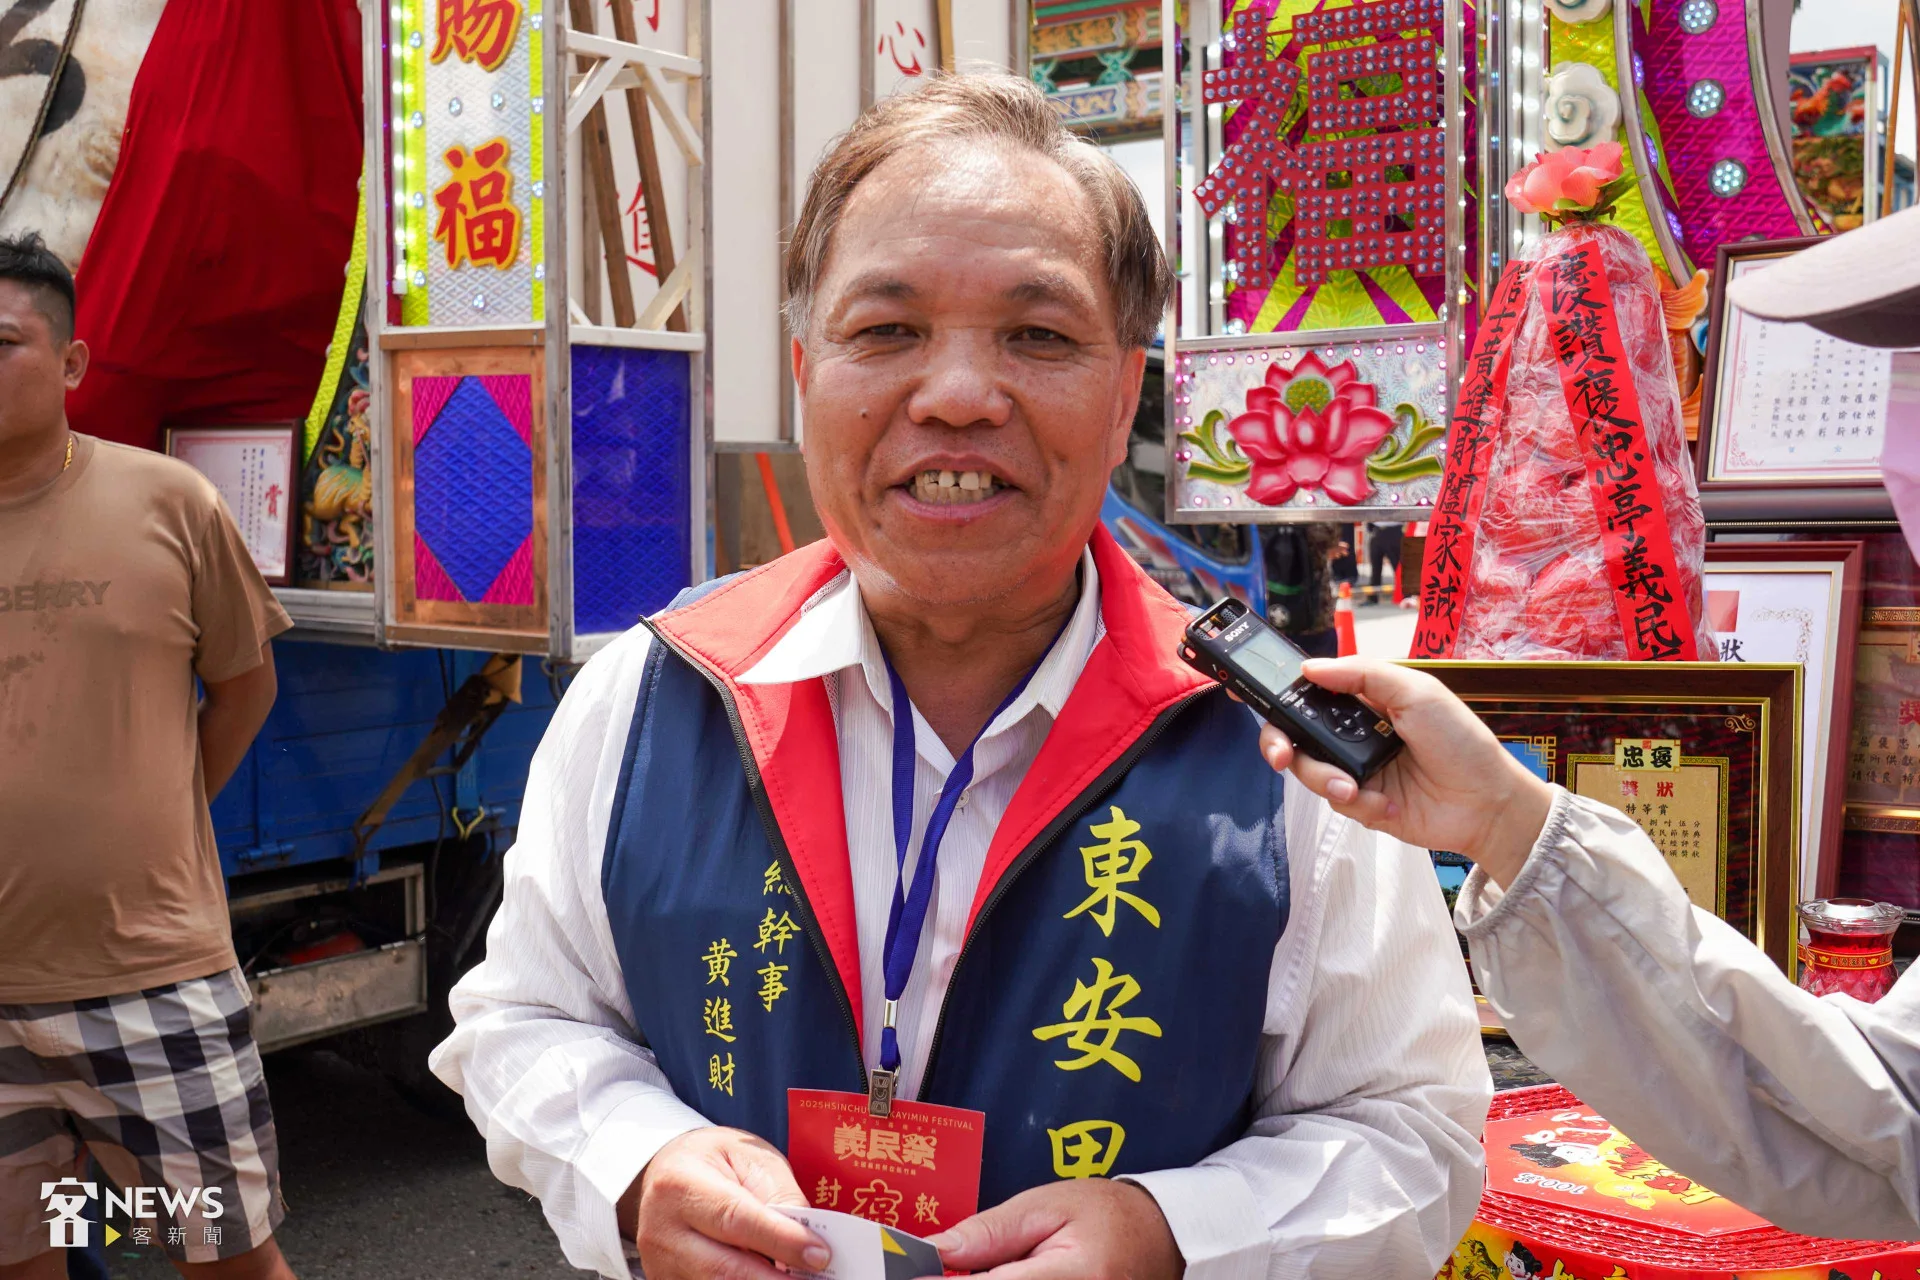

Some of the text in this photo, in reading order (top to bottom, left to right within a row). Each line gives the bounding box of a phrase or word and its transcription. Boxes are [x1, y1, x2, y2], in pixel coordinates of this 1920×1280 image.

[878, 21, 925, 76] 心
[1192, 0, 1446, 292] 福
[1416, 263, 1531, 660] 信士黃進財闔家誠心
[1548, 250, 1684, 661] 慶讚褒忠亭義民
[1224, 621, 1250, 643] SONY
[1621, 780, 1674, 798] 獎狀
[833, 1121, 938, 1171] 義民祭
[932, 1117, 974, 1131] FESTIVAL
[815, 1175, 842, 1208] 封
